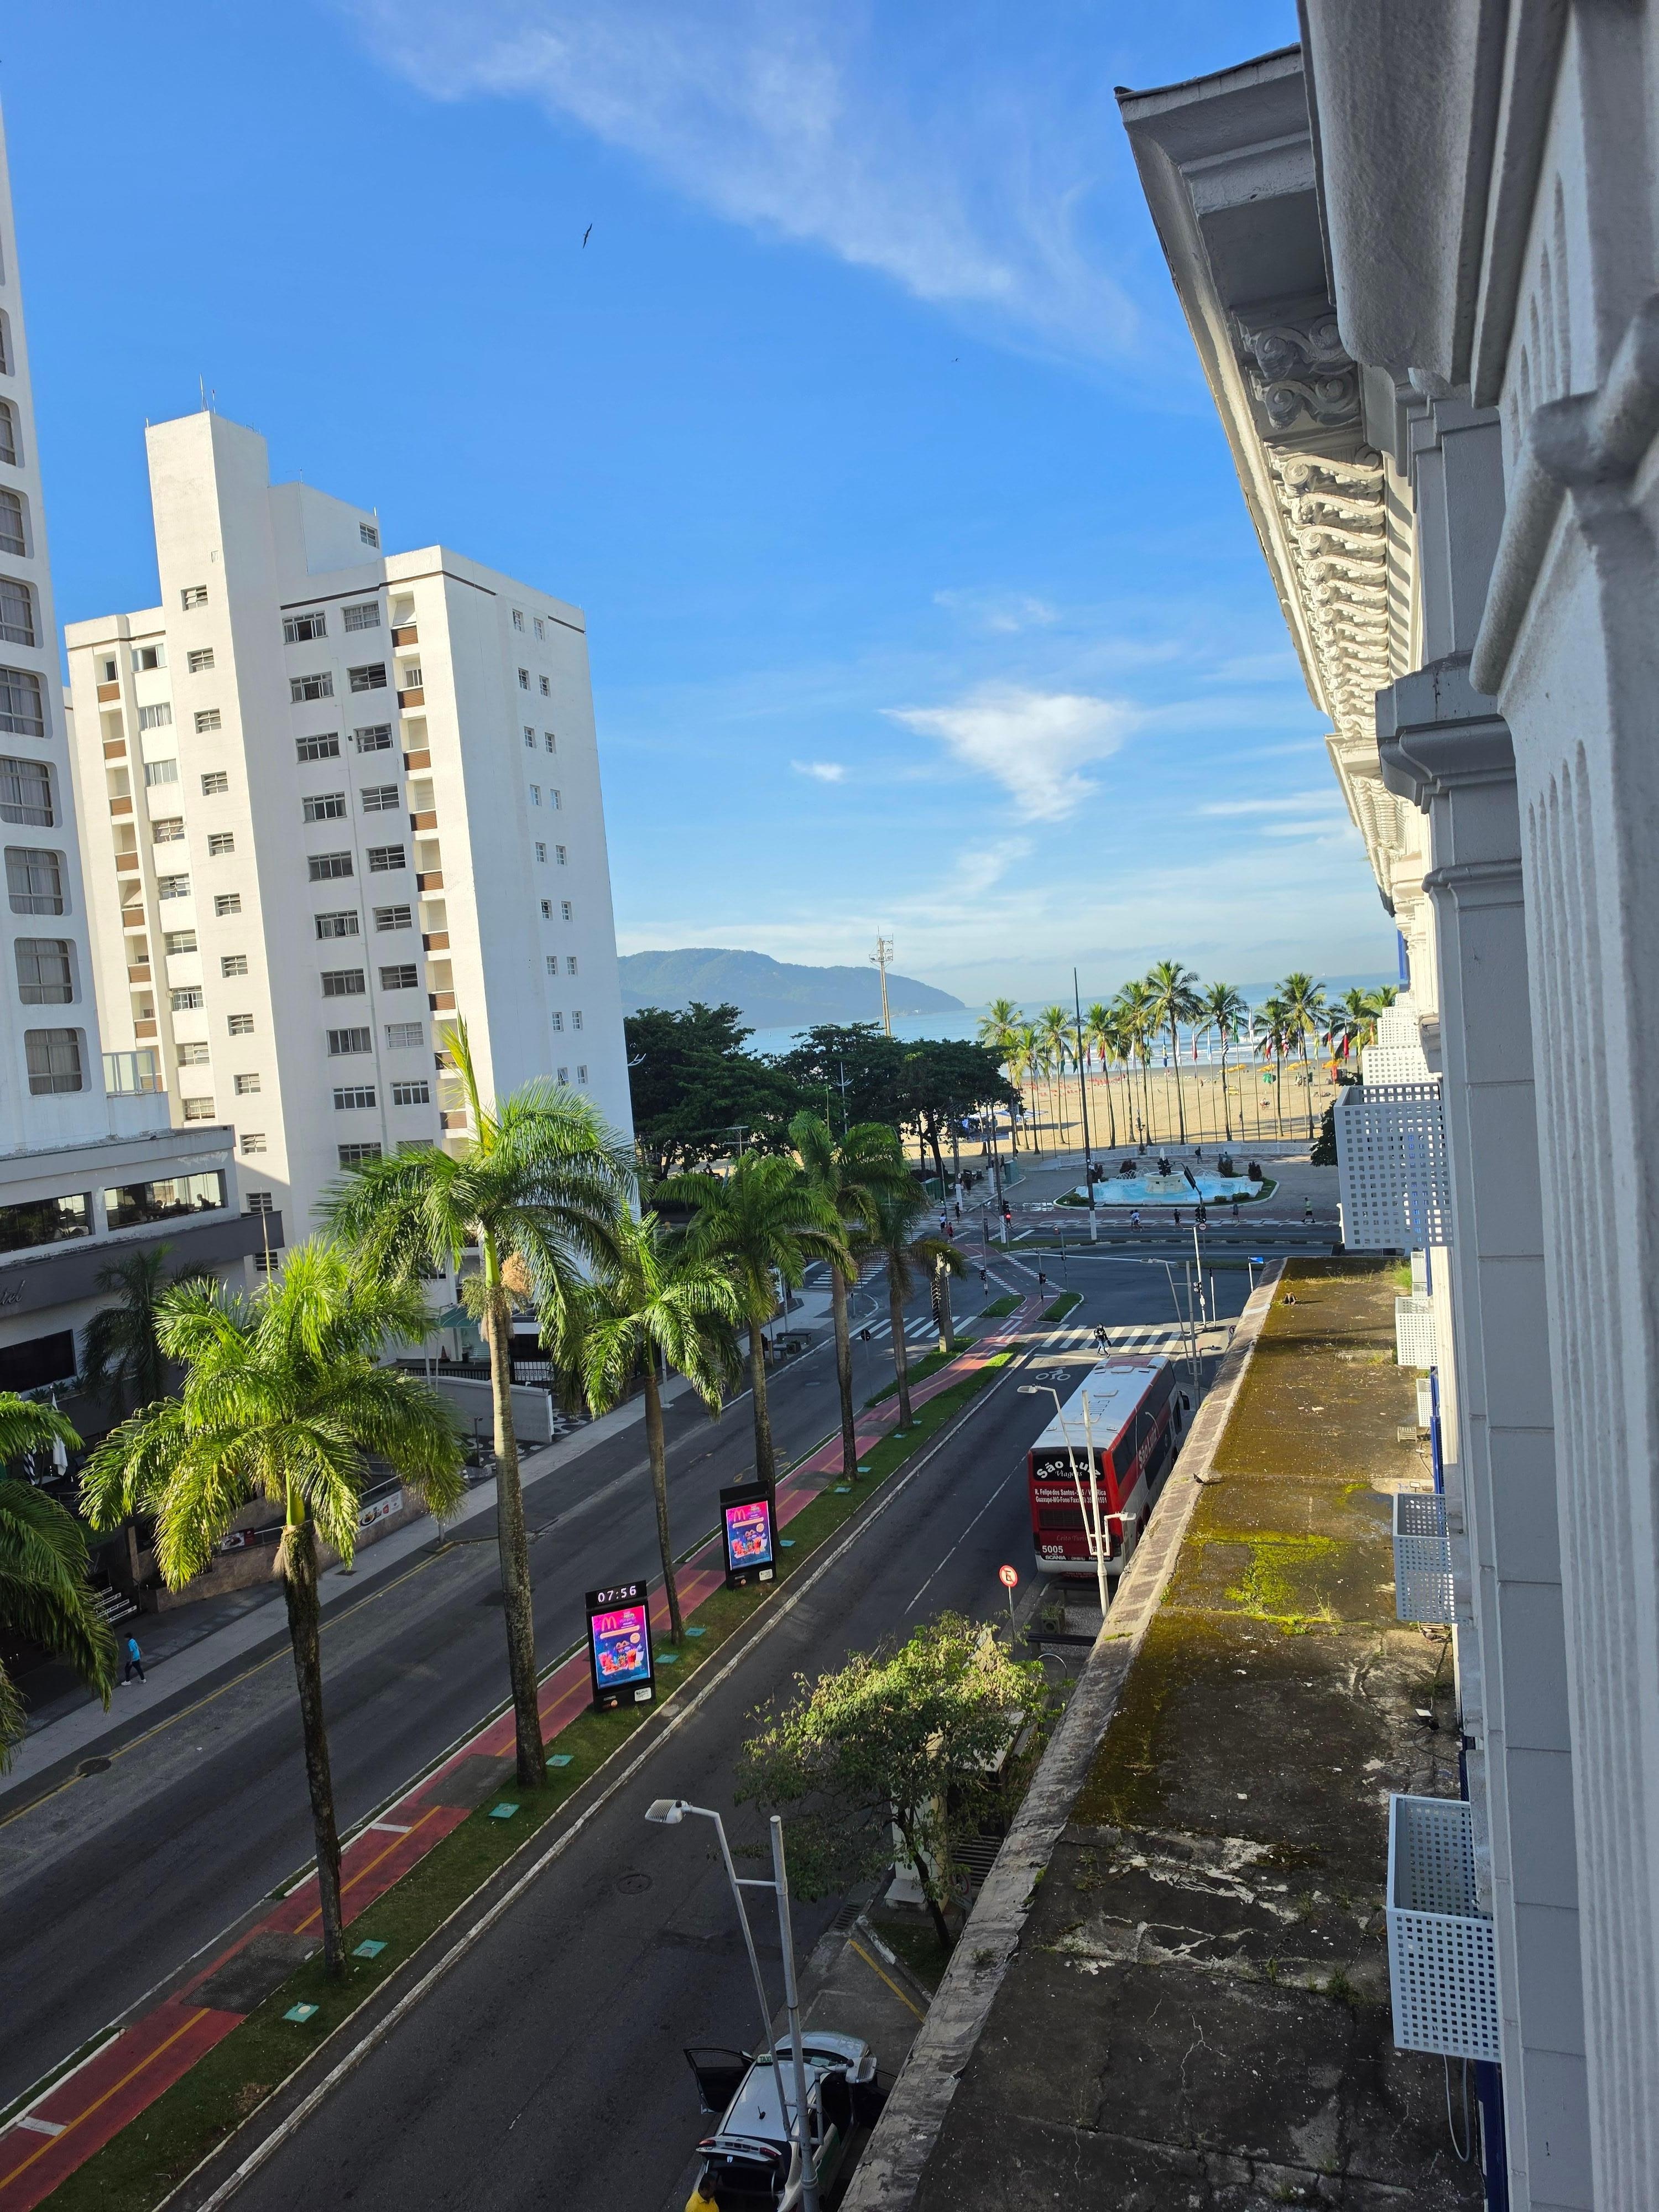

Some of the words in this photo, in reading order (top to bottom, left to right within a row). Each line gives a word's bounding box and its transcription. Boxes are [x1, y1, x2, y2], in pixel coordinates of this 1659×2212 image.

[1036, 1461, 1064, 1479] São
[1070, 1457, 1101, 1478] Luz
[1042, 1545, 1063, 1553] 5005
[598, 1585, 637, 1603] 07:56
